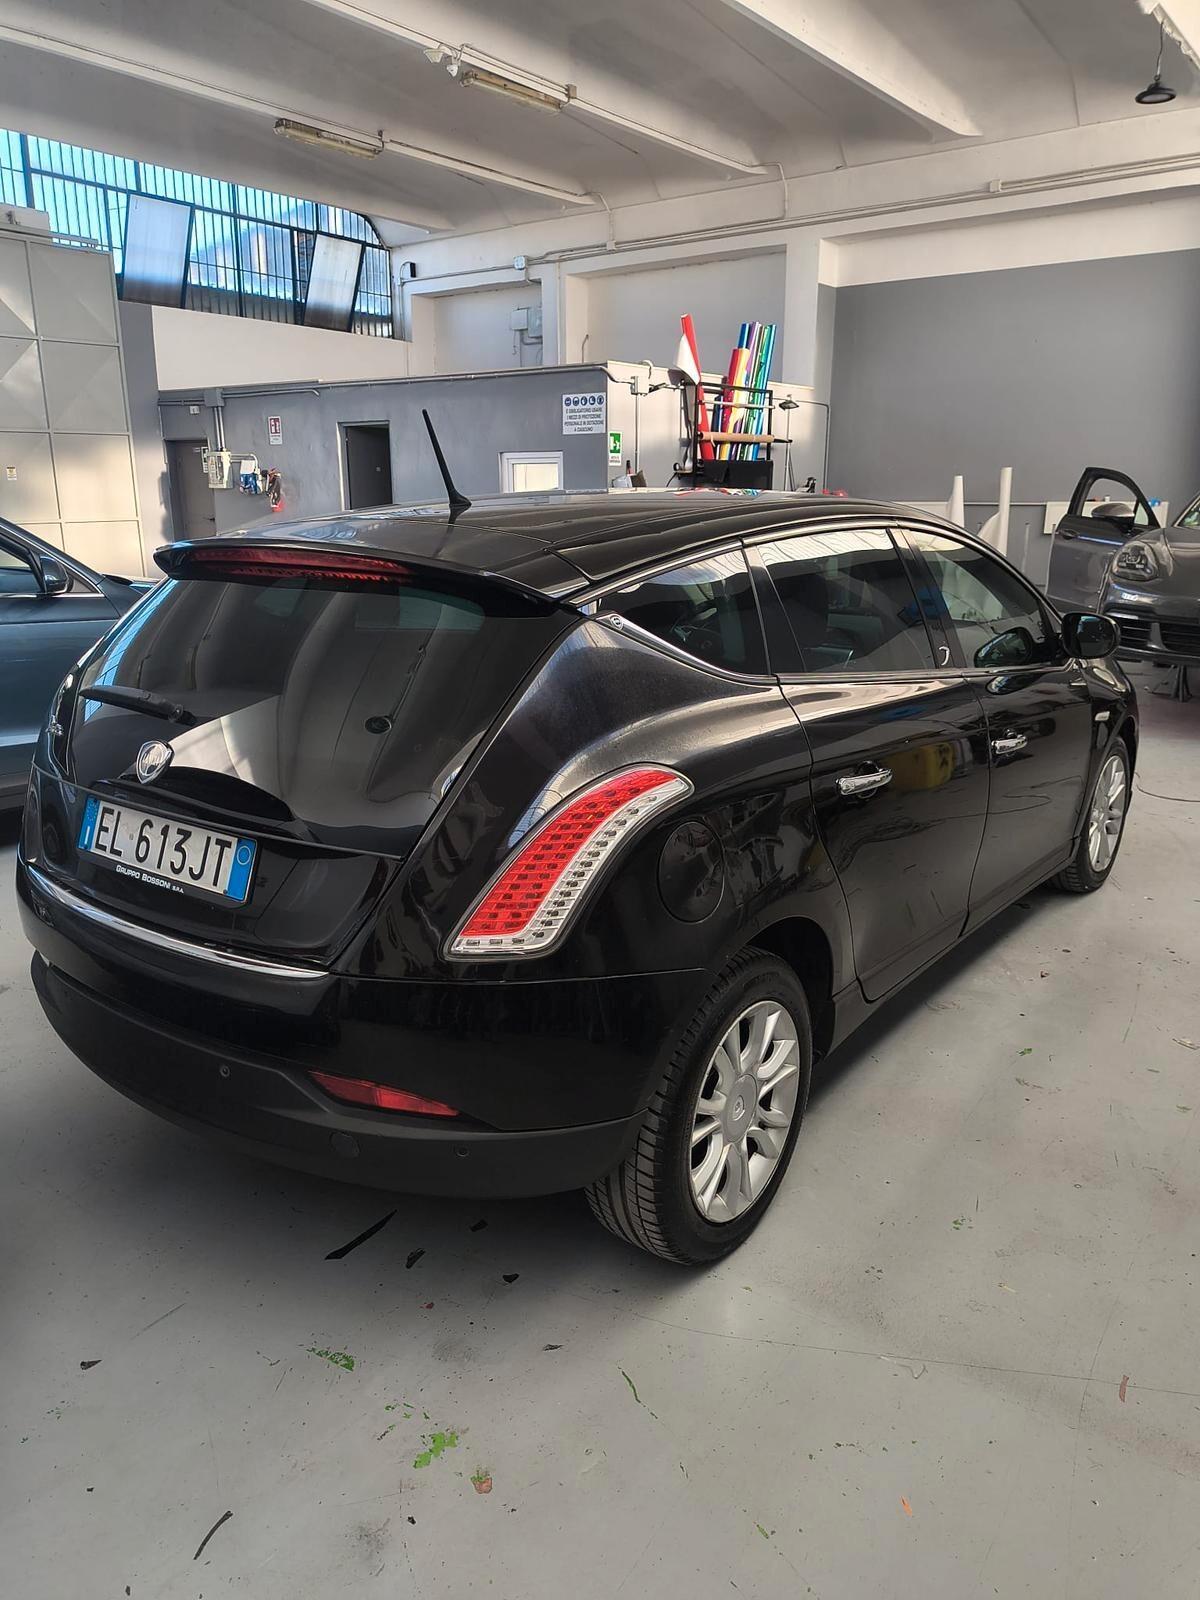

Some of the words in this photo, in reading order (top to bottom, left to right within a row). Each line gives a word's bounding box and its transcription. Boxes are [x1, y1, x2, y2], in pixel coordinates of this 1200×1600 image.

[95, 806, 123, 857] EL
[135, 819, 232, 887] 613JT
[116, 864, 140, 879] GRUPPO
[142, 873, 171, 889] BOSSONI
